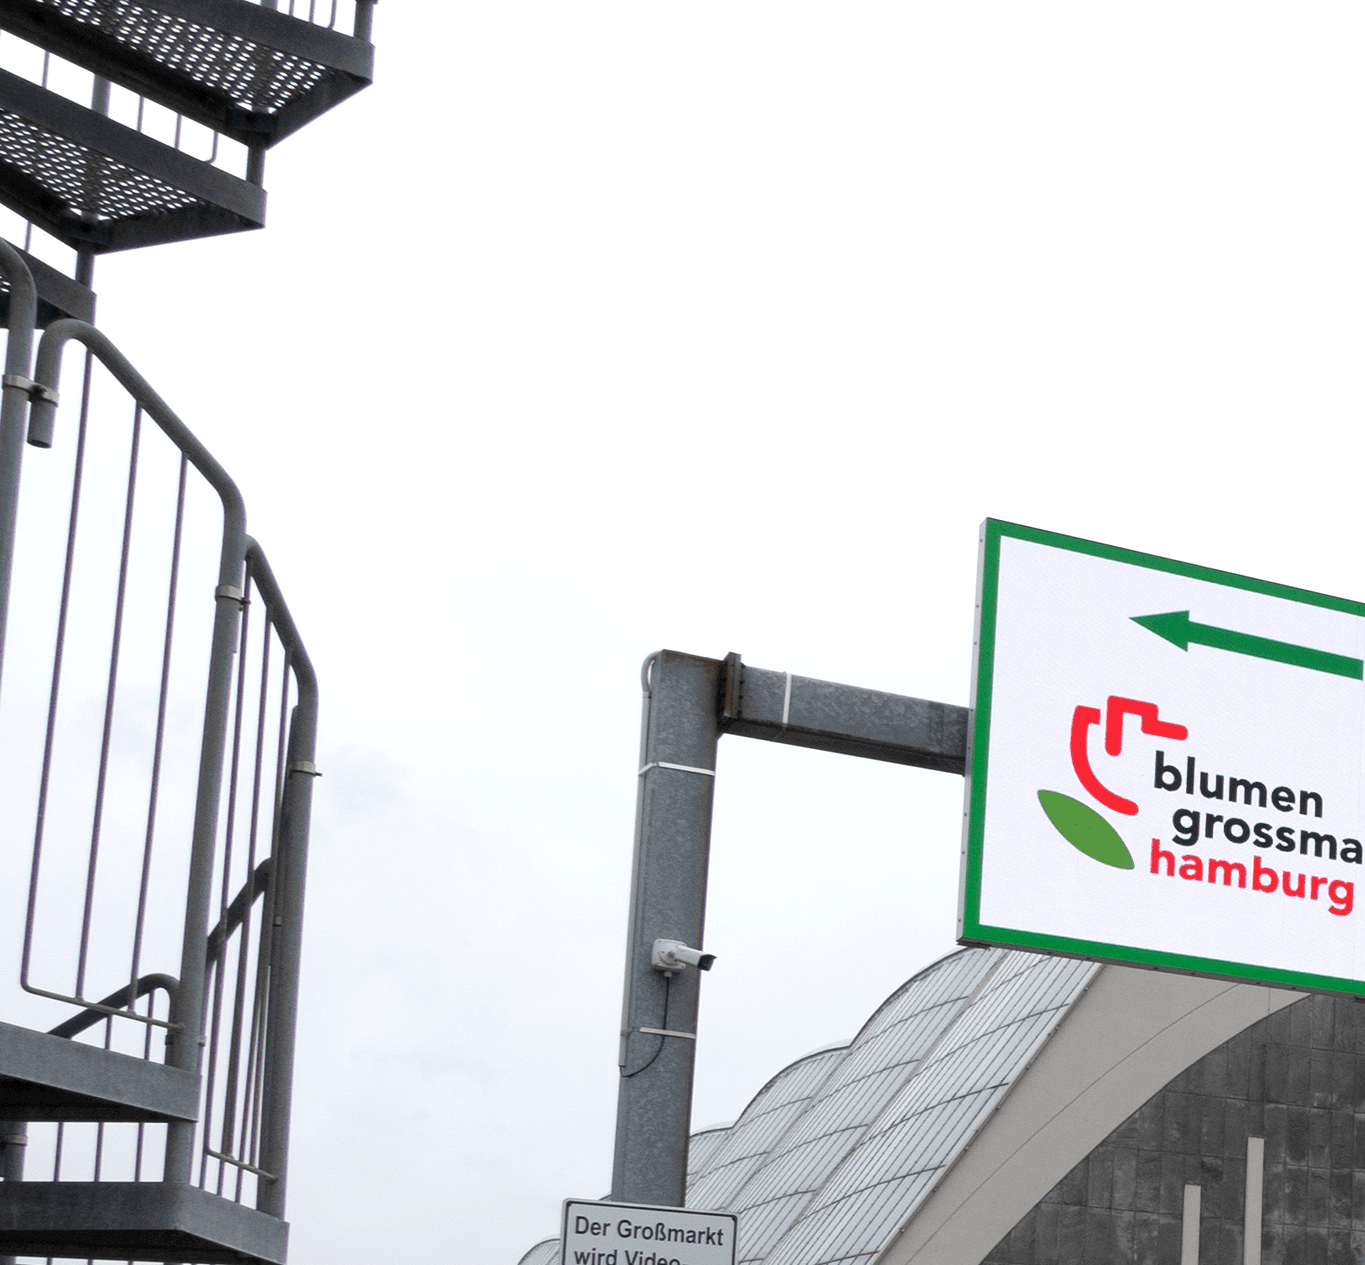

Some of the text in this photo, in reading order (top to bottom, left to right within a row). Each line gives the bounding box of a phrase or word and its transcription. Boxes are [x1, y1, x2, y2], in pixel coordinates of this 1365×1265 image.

[1154, 751, 1323, 818] blumen
[1150, 838, 1354, 916] hamburg
[575, 1216, 724, 1246] Der Großmarkt
